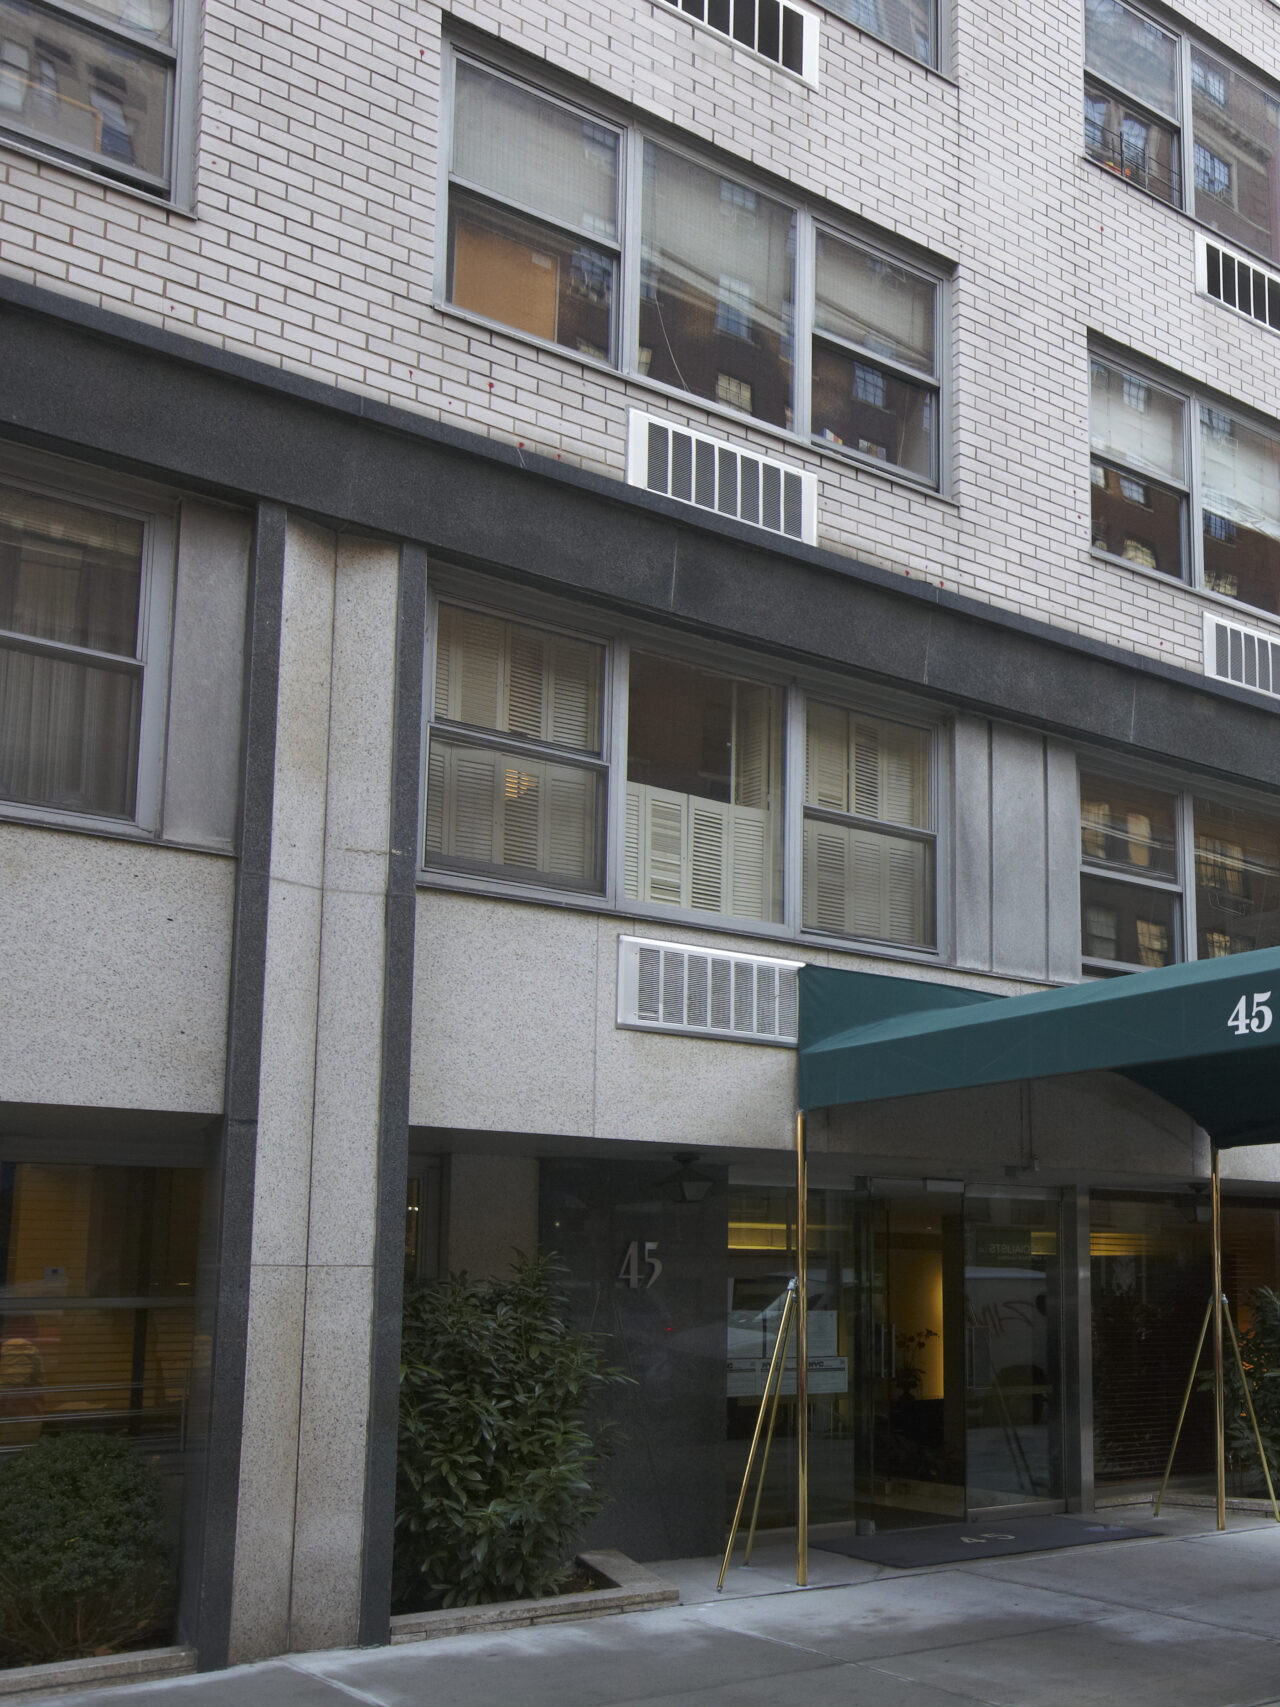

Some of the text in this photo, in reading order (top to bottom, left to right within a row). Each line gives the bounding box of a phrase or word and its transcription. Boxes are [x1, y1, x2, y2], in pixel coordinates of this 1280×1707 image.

[1227, 990, 1273, 1036] 45
[618, 1240, 663, 1289] 45
[960, 1533, 1016, 1543] 45
